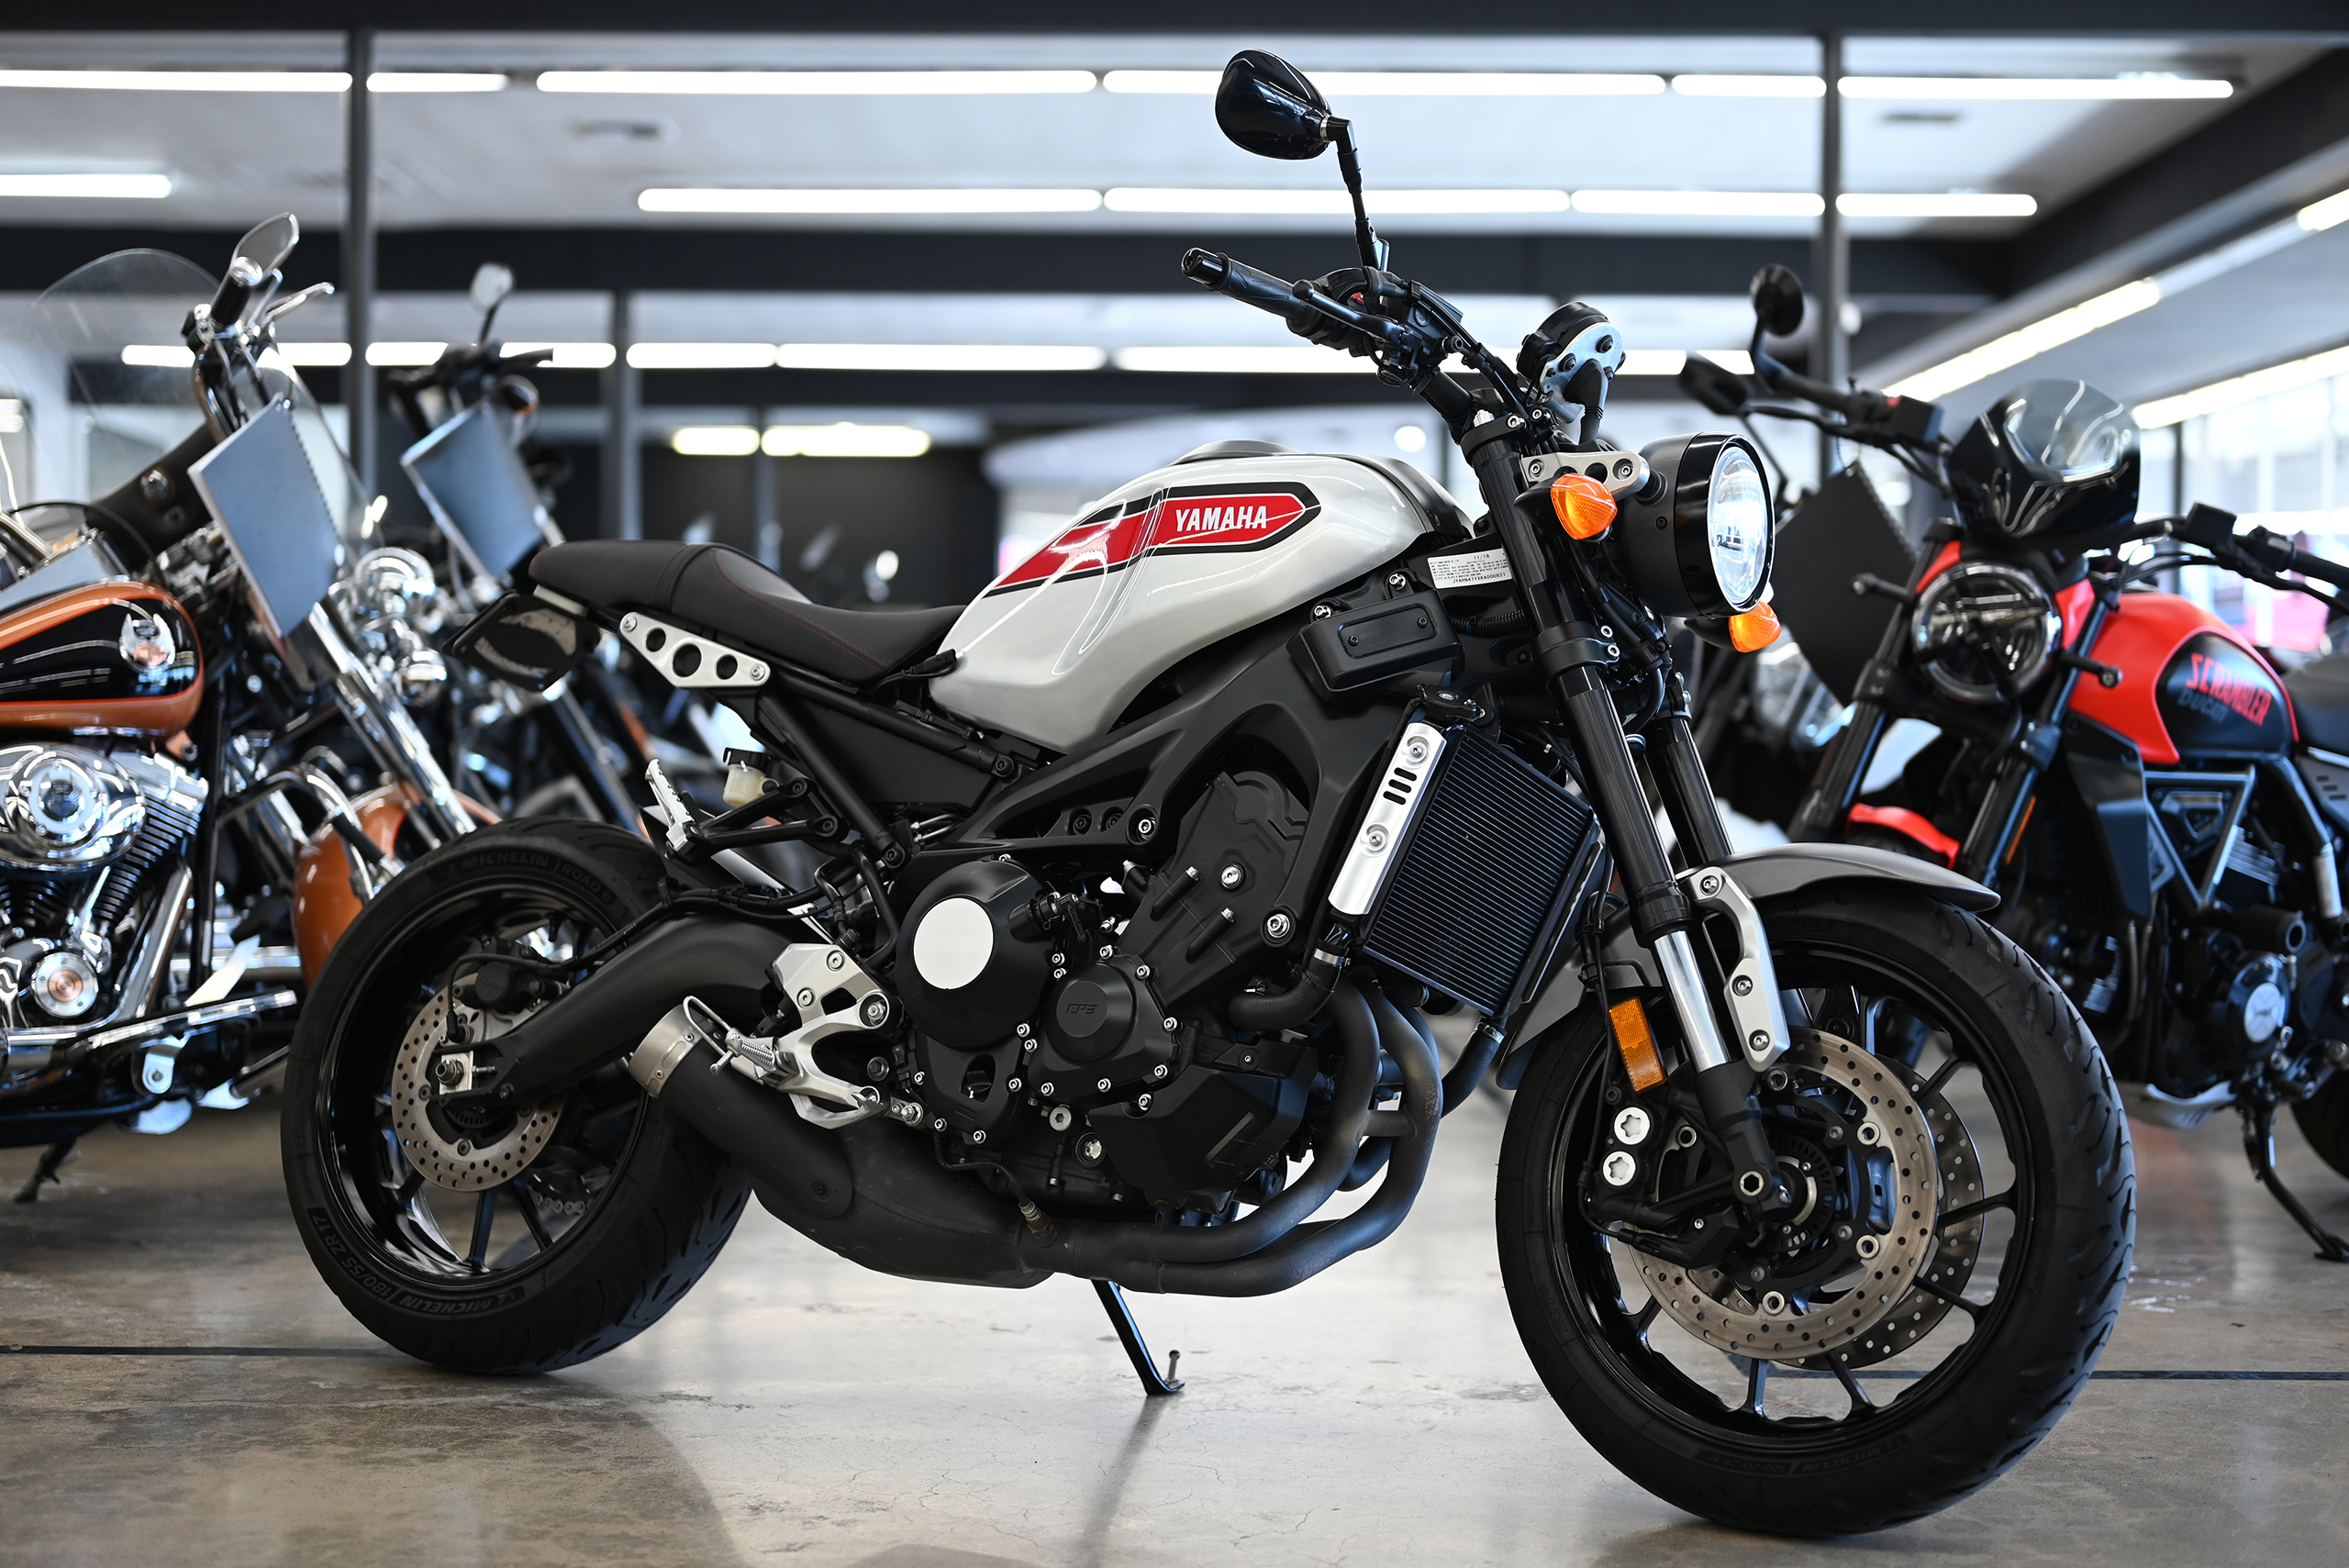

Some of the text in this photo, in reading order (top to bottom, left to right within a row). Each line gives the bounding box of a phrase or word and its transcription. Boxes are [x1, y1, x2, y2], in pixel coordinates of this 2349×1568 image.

[1175, 505, 1268, 532] YAMAHA
[2186, 651, 2272, 727] SCRAMBLER
[462, 851, 612, 904] MICHELIN ROAD 6
[312, 1214, 492, 1315] MICHELIN 180/55 ZR 17
[1742, 1461, 1786, 1473] 120/70
[1802, 1447, 1881, 1473] MICHELIN
